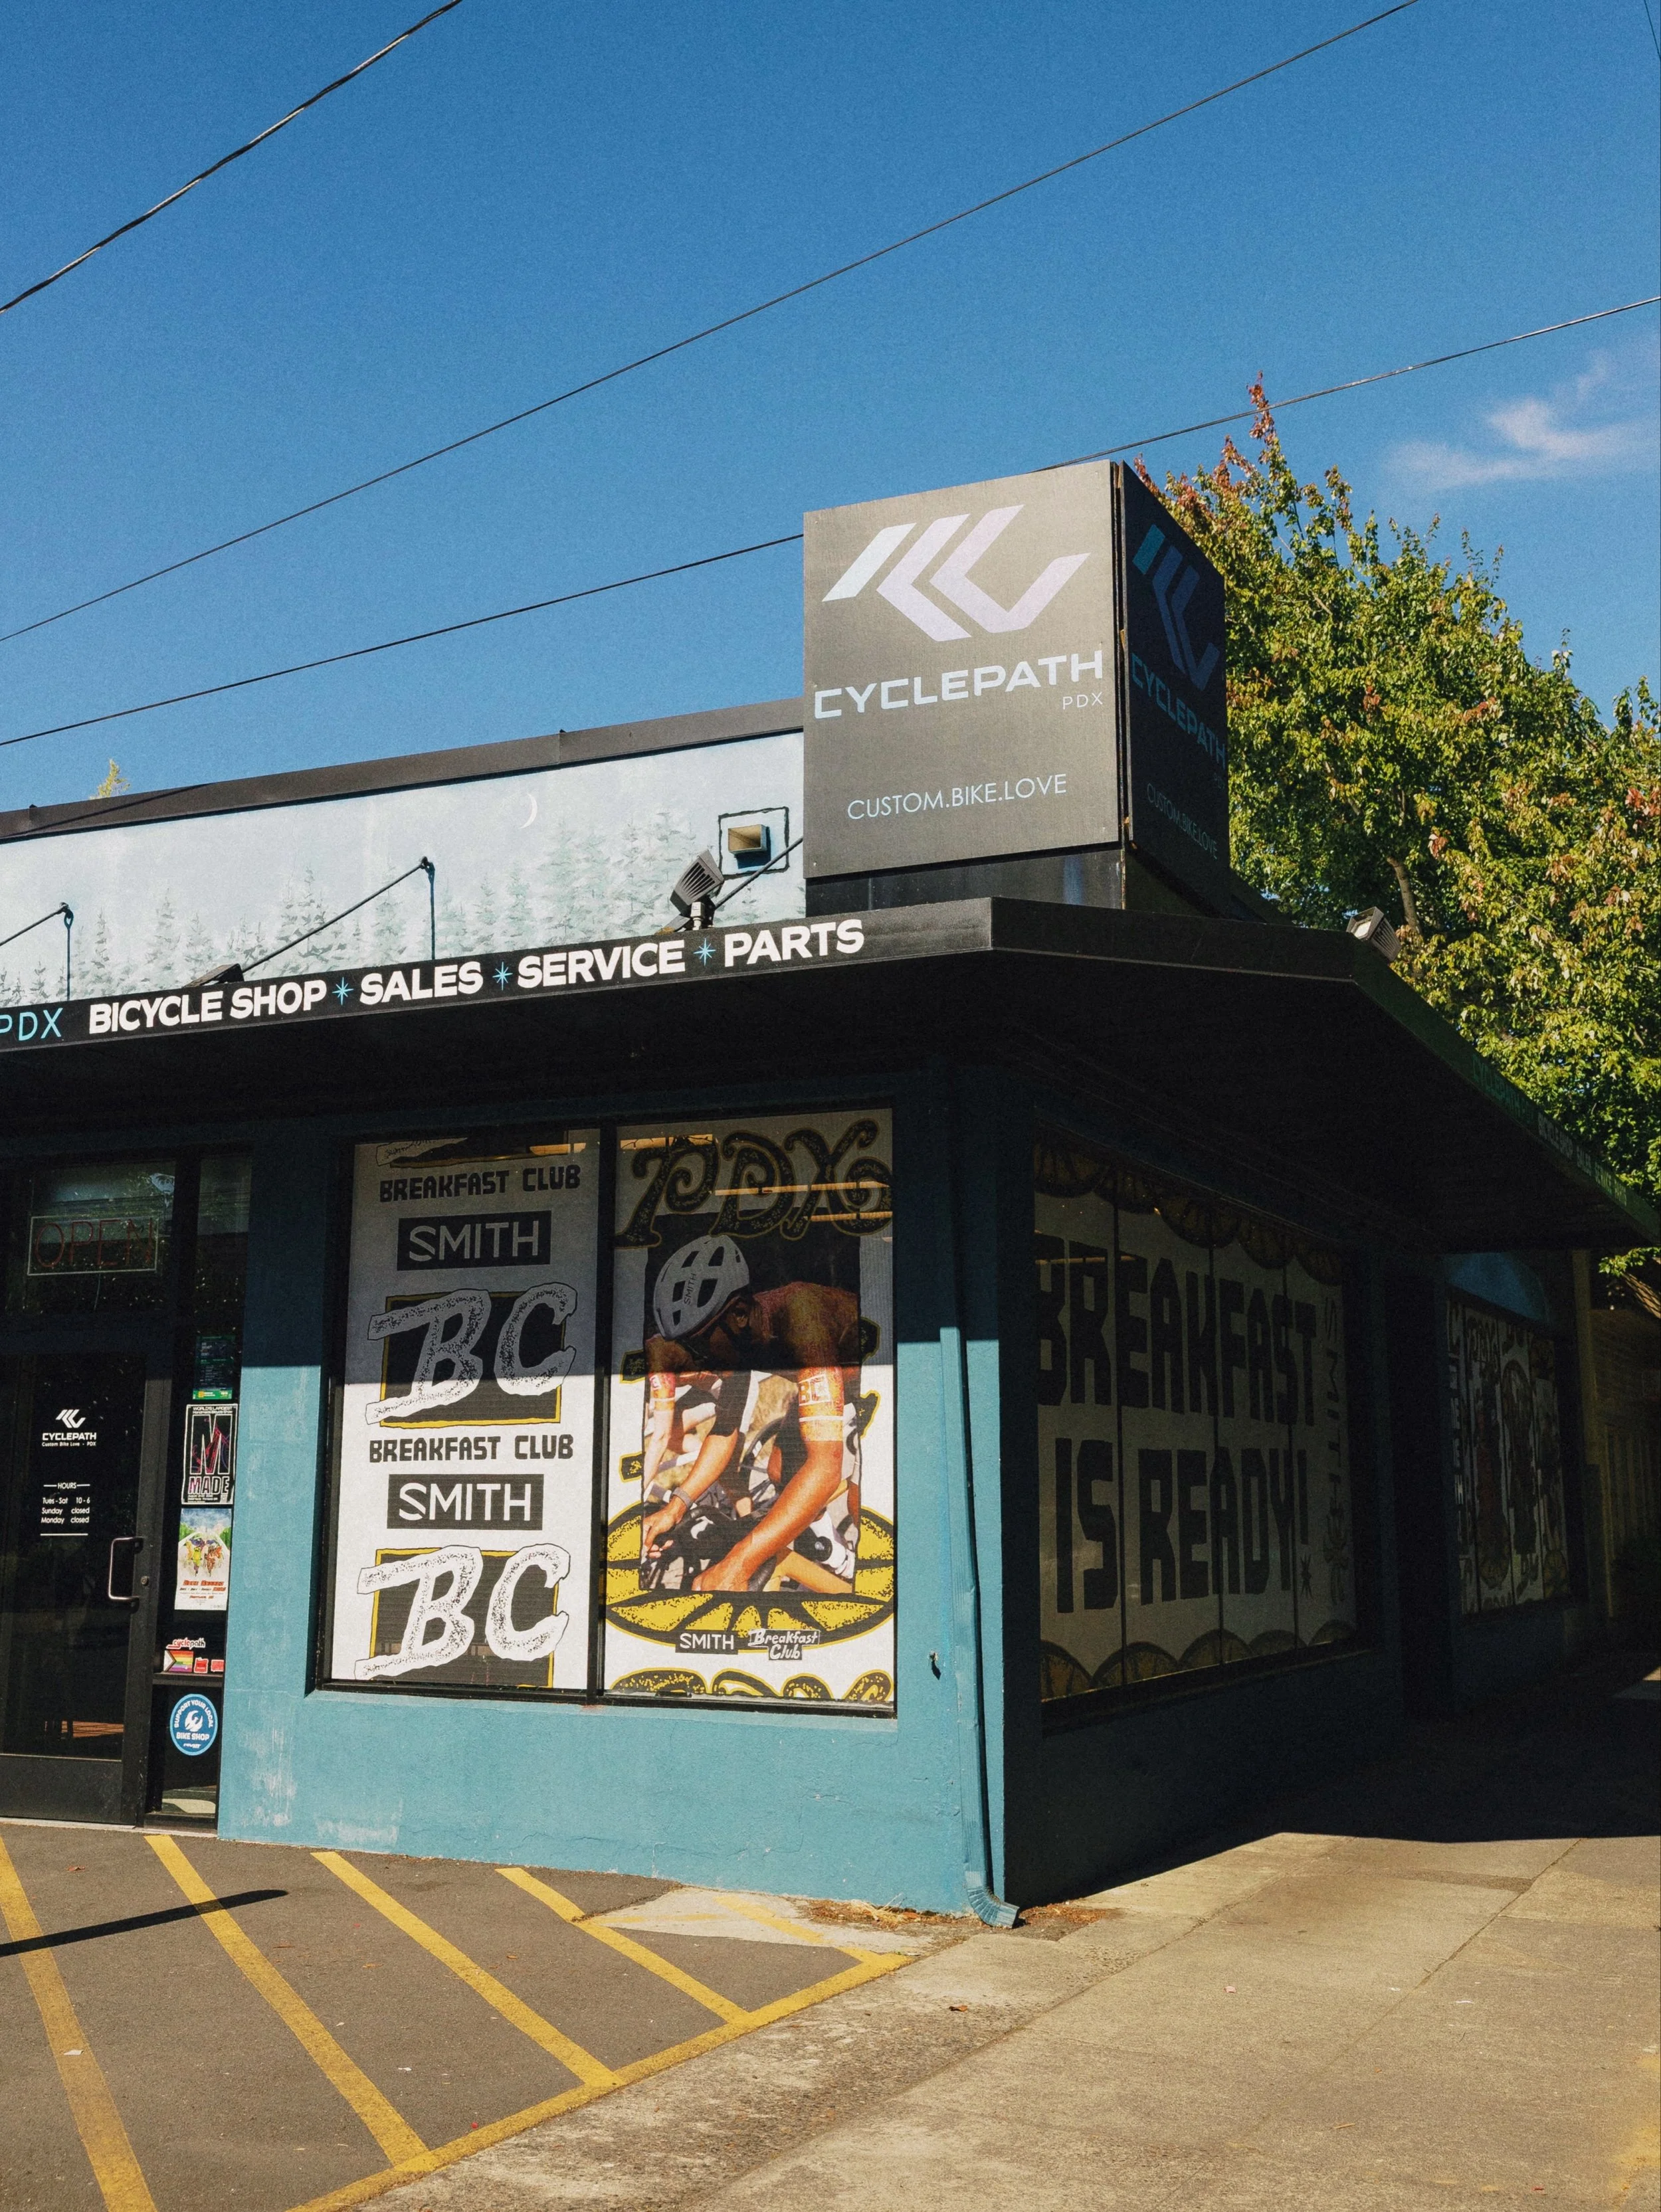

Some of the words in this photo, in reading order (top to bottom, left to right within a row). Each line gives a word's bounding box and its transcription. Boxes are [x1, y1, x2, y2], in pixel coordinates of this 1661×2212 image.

[814, 650, 1104, 719] CYCLEPATH
[1062, 691, 1104, 711] PDX
[1131, 652, 1226, 769] CYCLEPATH
[847, 773, 1067, 821] CUSTOM.BIKE.LOVE
[89, 990, 223, 1035] BICYCLE
[230, 978, 327, 1020] SHOP
[359, 961, 484, 1006] SALES
[517, 939, 686, 988] SERVICE
[724, 918, 865, 968] PARTS
[379, 1170, 510, 1203] BREAKFAST
[522, 1164, 581, 1192] CLUB
[35, 1217, 153, 1269] OPEN
[409, 1220, 539, 1261] SMITH
[684, 1272, 696, 1305] SMITH
[1036, 1231, 1318, 1427] BREAKFAST
[365, 1281, 579, 1426] BC
[42, 1432, 97, 1441] CYCLEPATH
[369, 1435, 501, 1463] BREAKFAST
[514, 1434, 574, 1460] CLUB
[188, 1476, 230, 1495] MADE
[399, 1482, 532, 1521] SMITH
[1055, 1437, 1119, 1613] IS
[353, 1542, 571, 1681] BC
[679, 1632, 735, 1651] SMITH
[748, 1628, 820, 1647] Breakfast
[769, 1645, 801, 1661] Club
[174, 1700, 191, 1728] SUPPORT
[190, 1699, 207, 1710] YOUR
[204, 1706, 214, 1728] LOCAL
[176, 1732, 191, 1740] BIKE
[191, 1732, 210, 1741] SHOP
